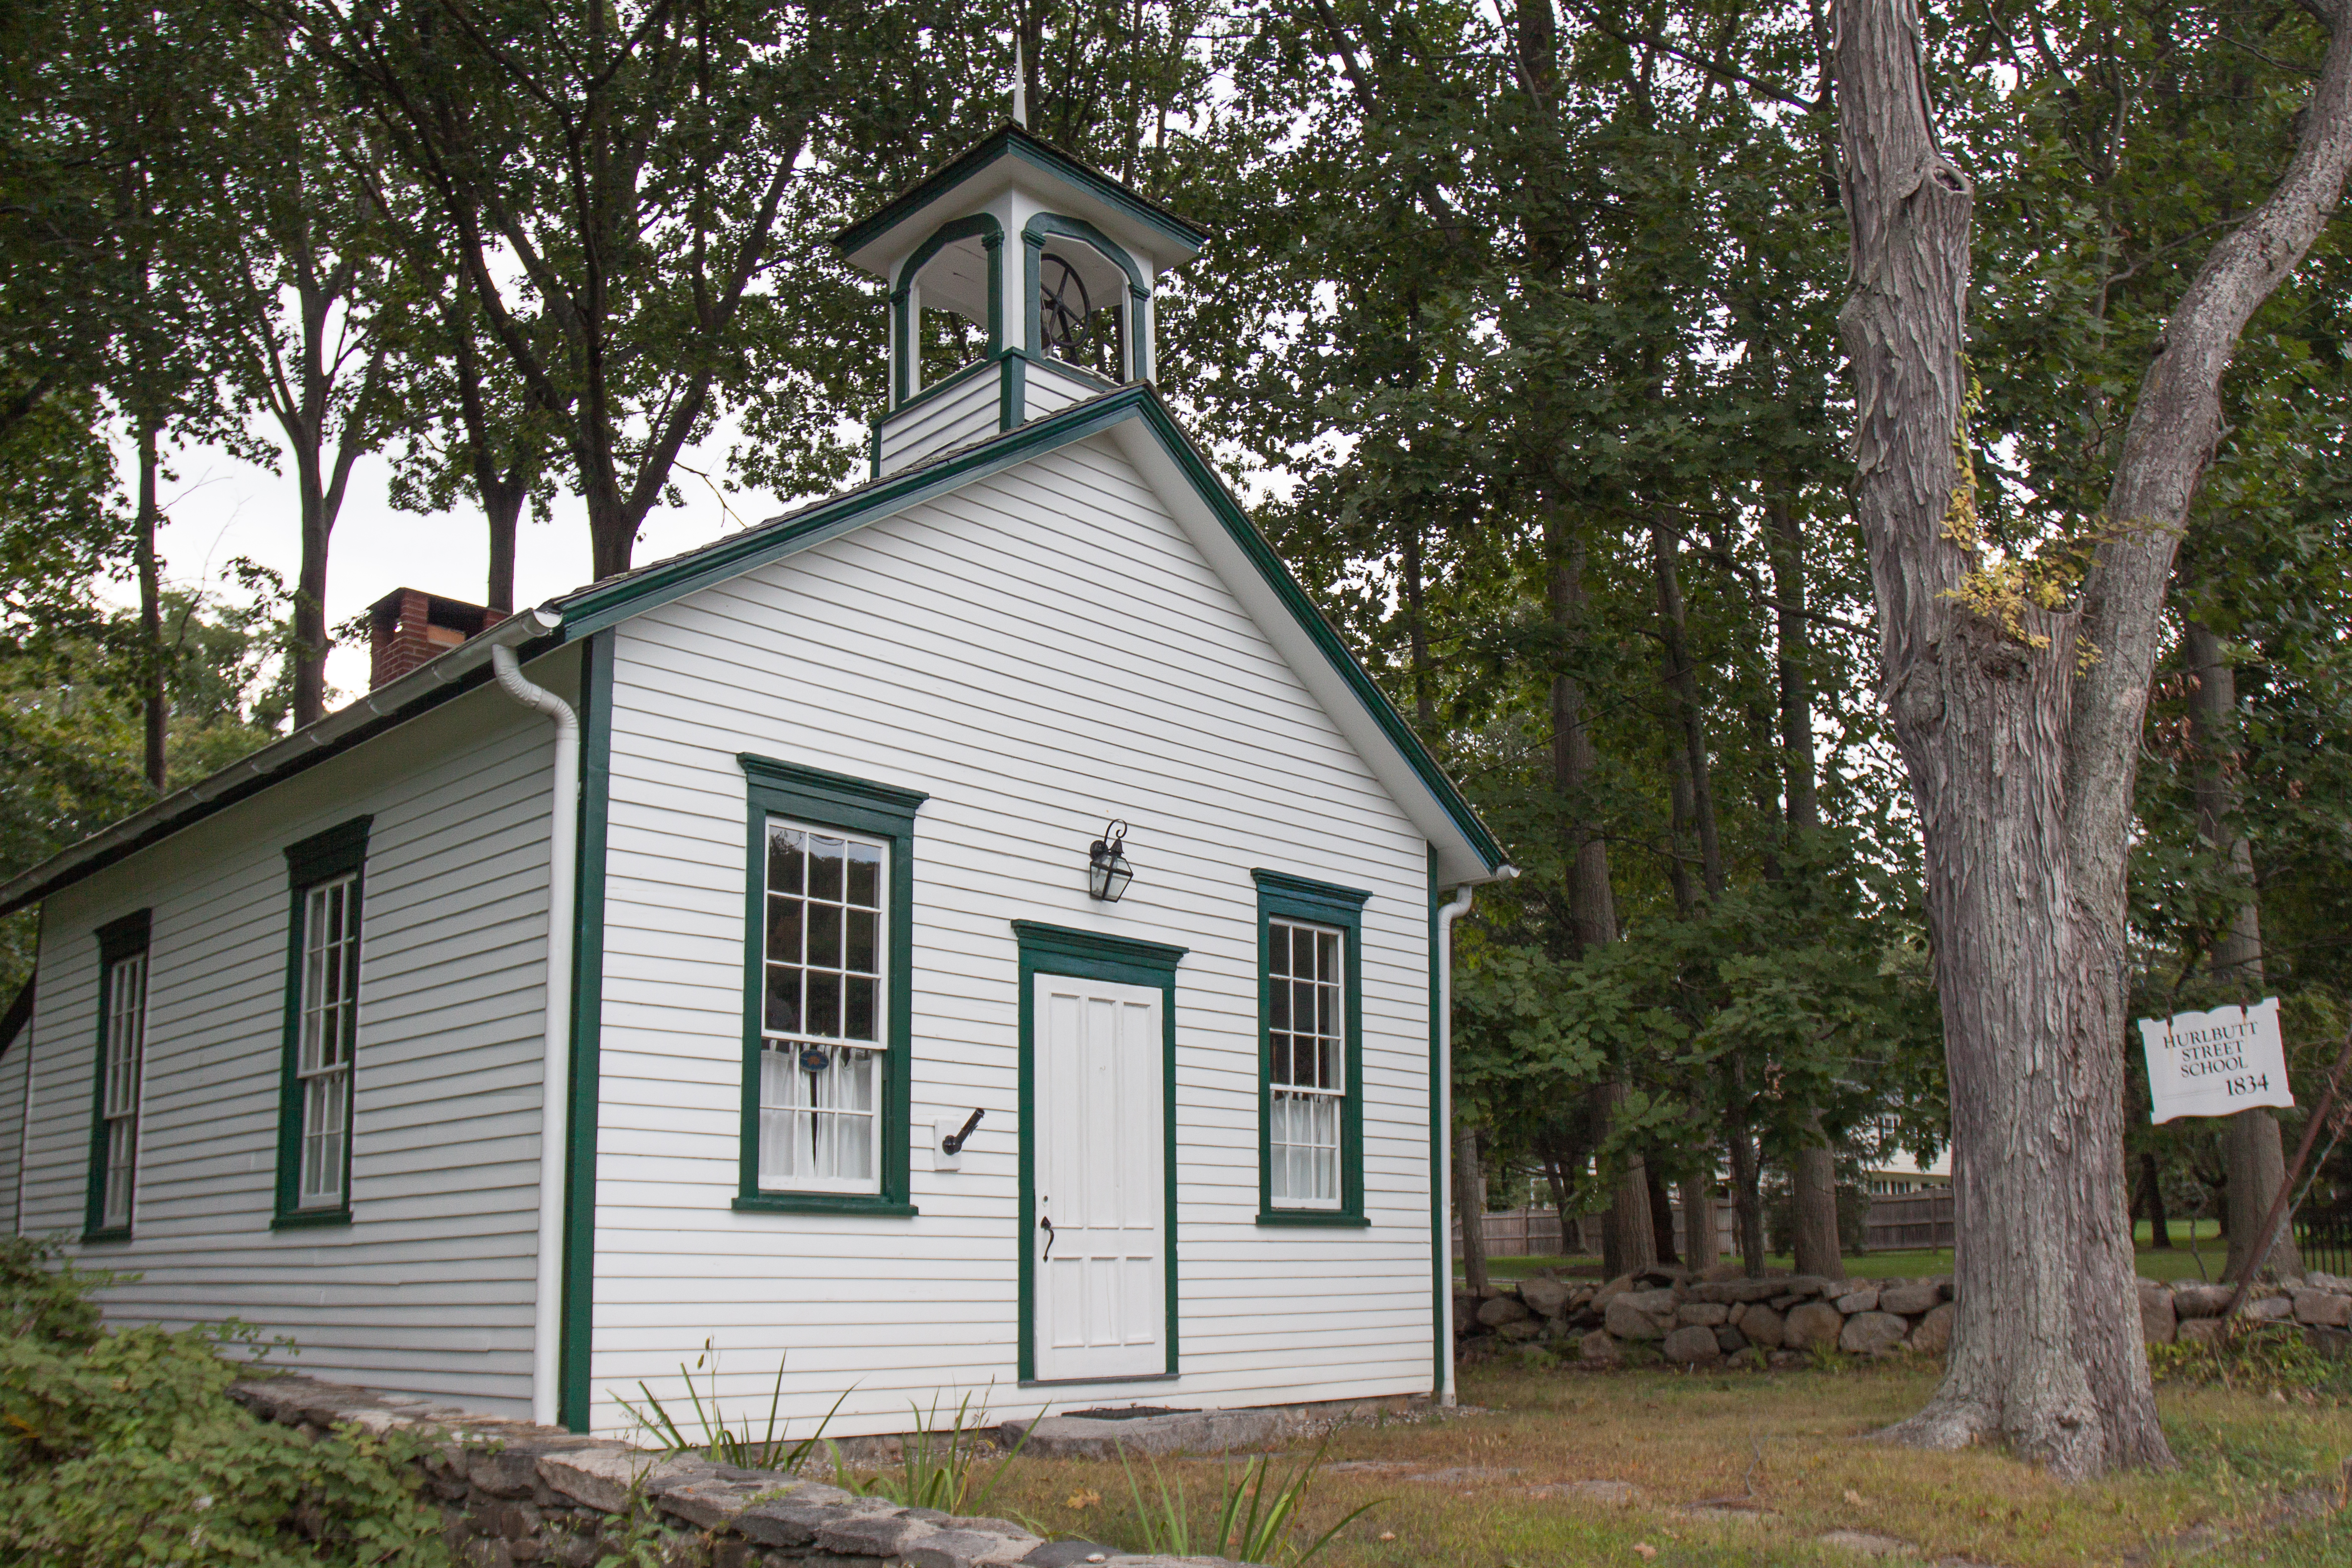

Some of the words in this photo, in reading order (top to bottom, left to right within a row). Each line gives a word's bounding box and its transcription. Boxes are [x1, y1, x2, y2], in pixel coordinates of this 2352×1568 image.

[2163, 1021, 2257, 1049] HURLBUTT
[2182, 1040, 2244, 1062] STREET
[2181, 1056, 2248, 1078] SCHOOL
[2226, 1073, 2268, 1096] 1834
